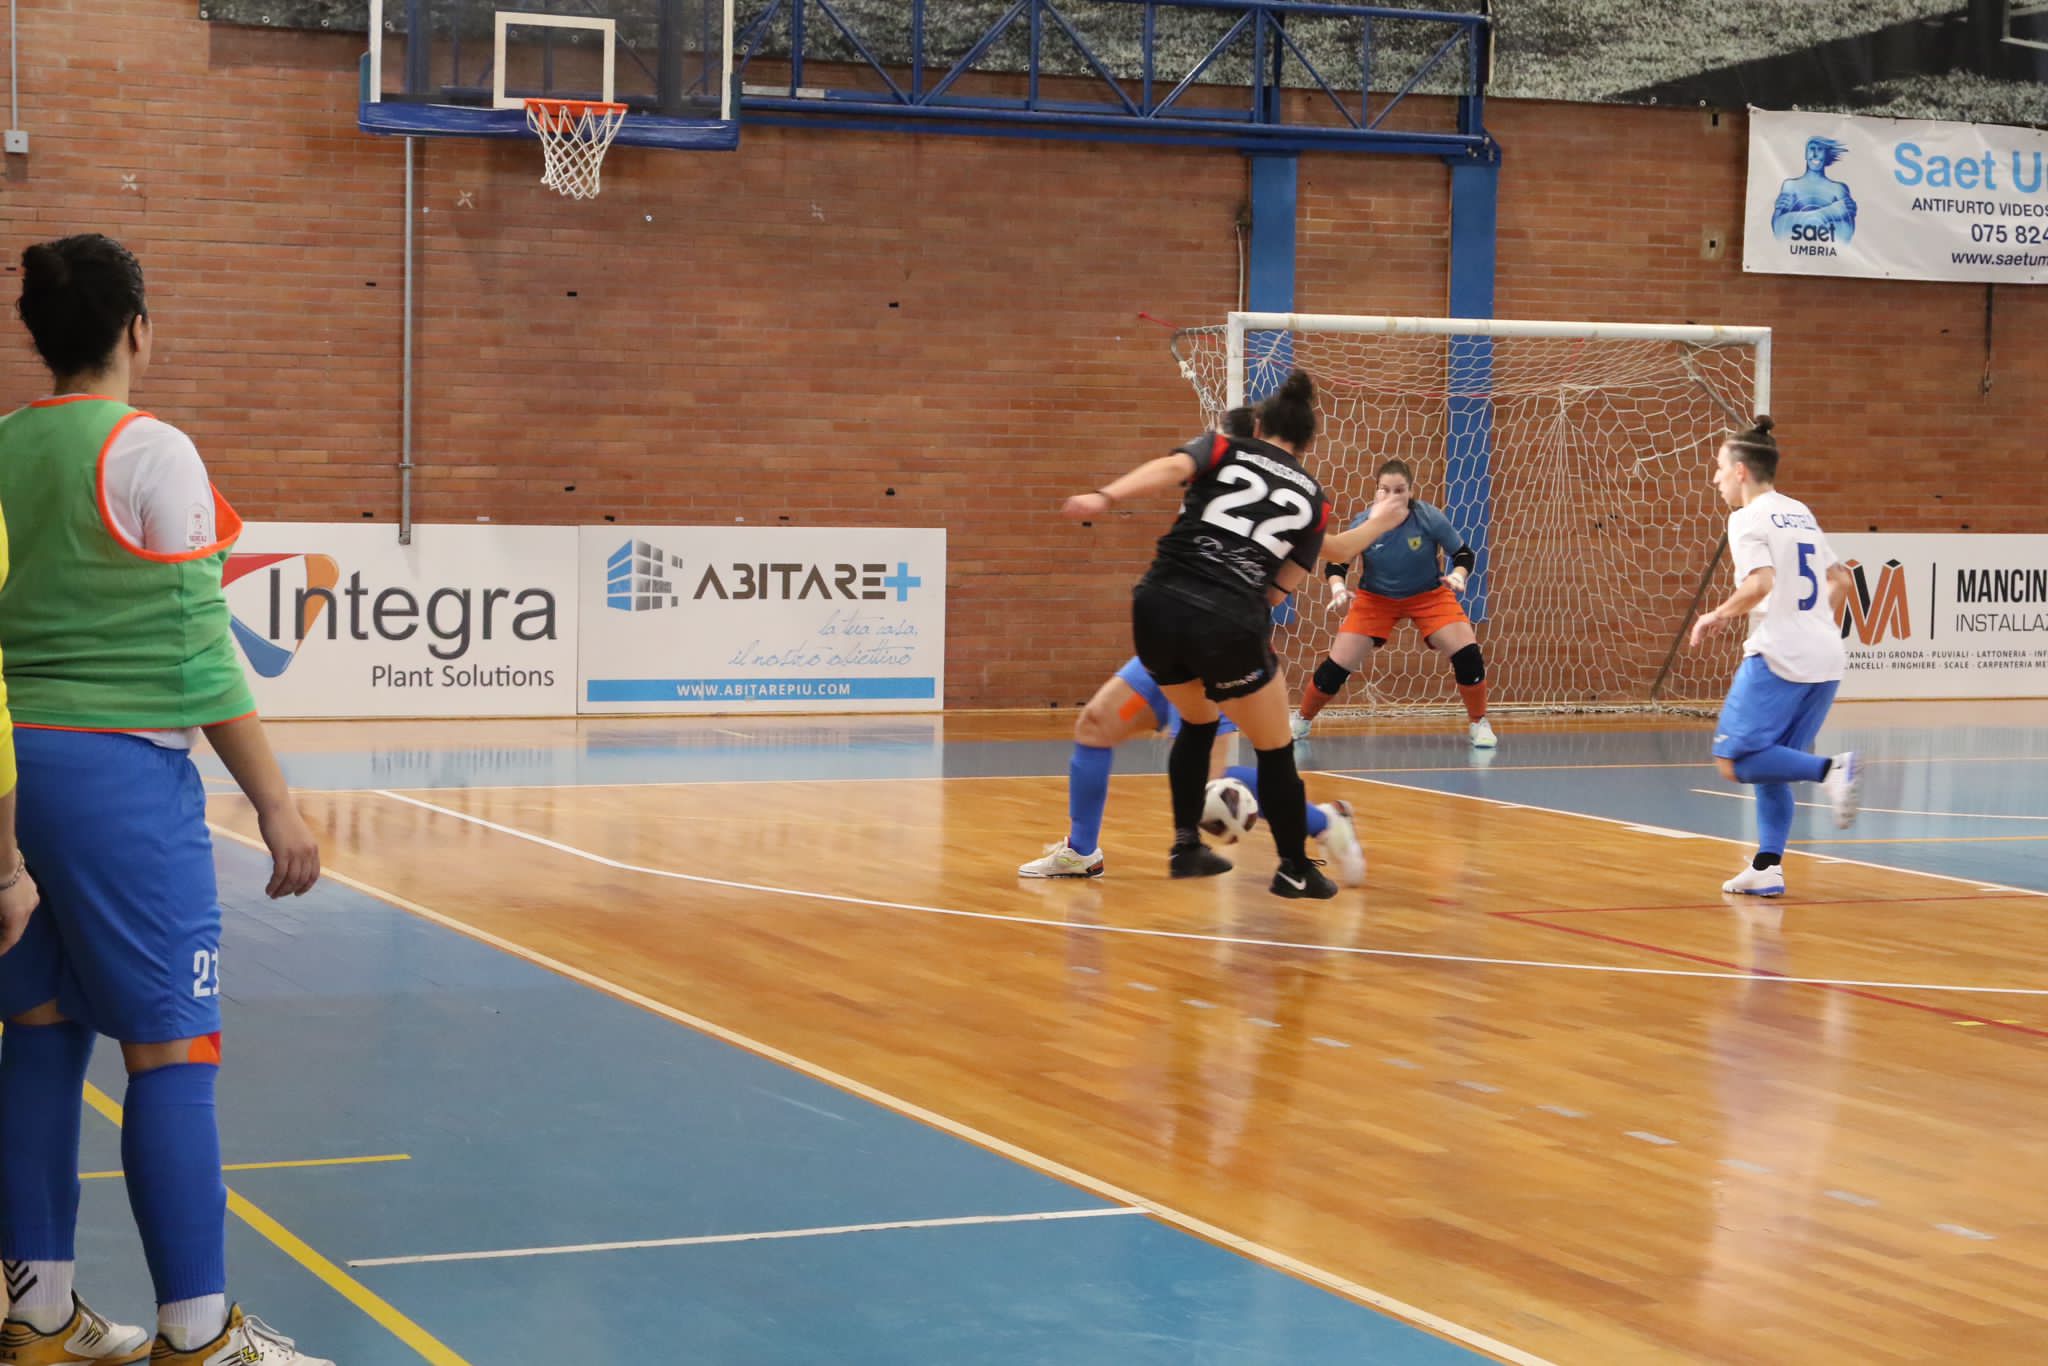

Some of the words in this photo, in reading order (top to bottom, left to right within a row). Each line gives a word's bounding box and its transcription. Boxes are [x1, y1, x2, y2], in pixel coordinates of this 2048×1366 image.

[1894, 142, 1997, 191] Saet
[2012, 150, 2048, 194] U
[1911, 197, 1995, 216] ANTIFURTO
[1971, 223, 2008, 245] 075
[1790, 245, 1837, 257] UMBRIA
[1201, 464, 1313, 560] 22
[1796, 542, 1819, 611] 5
[1957, 568, 2047, 603] MANCIN
[269, 568, 557, 661] Integra
[1956, 613, 2048, 632] INSTALLA
[1877, 651, 1887, 659] DI
[1888, 650, 1924, 660] GRONDA
[1931, 650, 1969, 659] PLUVIALI
[1976, 650, 2027, 659] LATTONERIA
[1891, 661, 1936, 670] RINGHIERE
[1944, 661, 1969, 670] SCALE
[1977, 660, 2033, 669] CARPENTERIA
[372, 664, 434, 688] Plant
[442, 664, 555, 688] Solutions
[676, 682, 851, 698] WWW.ABITAREPIU.COM
